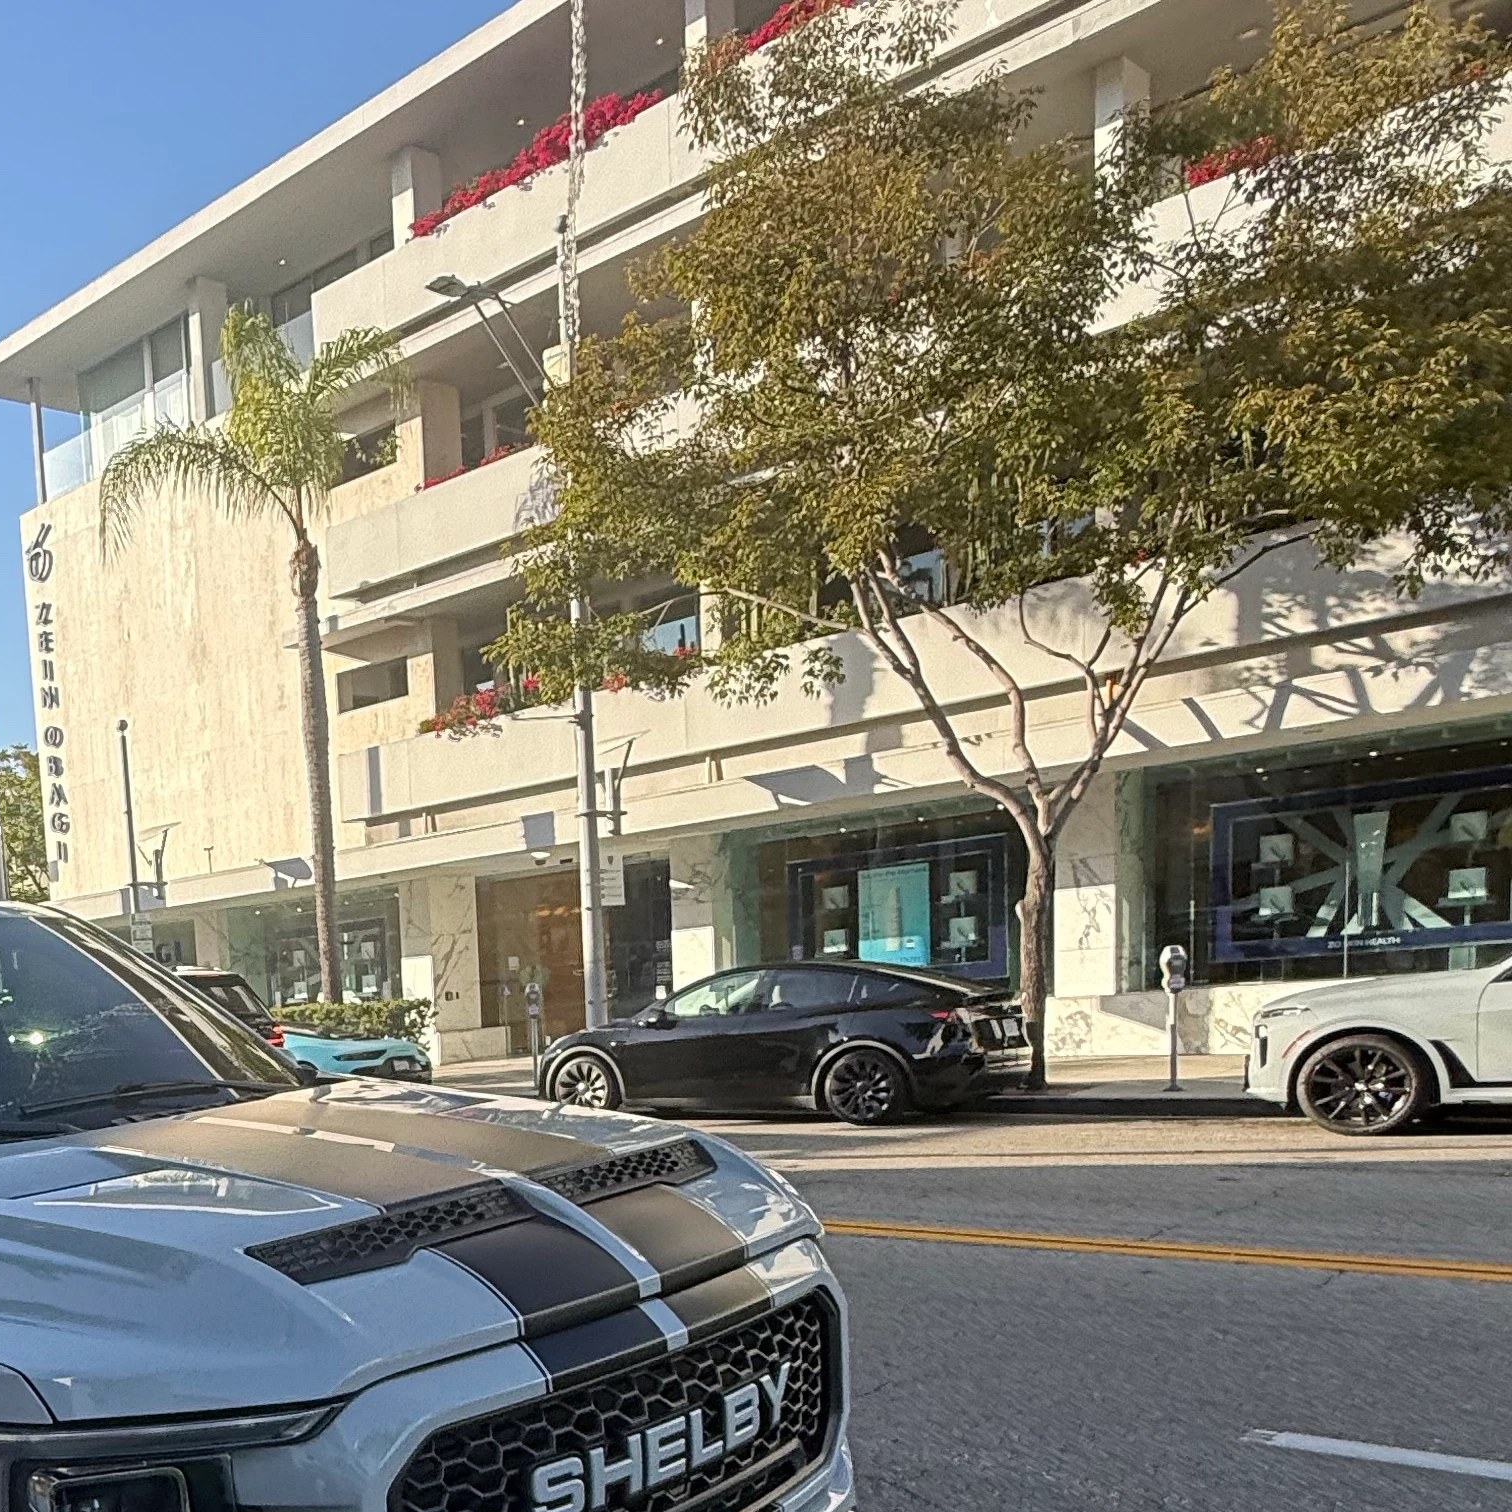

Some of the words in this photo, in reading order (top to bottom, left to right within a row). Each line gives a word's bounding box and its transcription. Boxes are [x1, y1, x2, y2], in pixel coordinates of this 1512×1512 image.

[34, 602, 60, 710] ZEIN
[42, 725, 71, 864] OBAGI
[155, 940, 183, 963] GI
